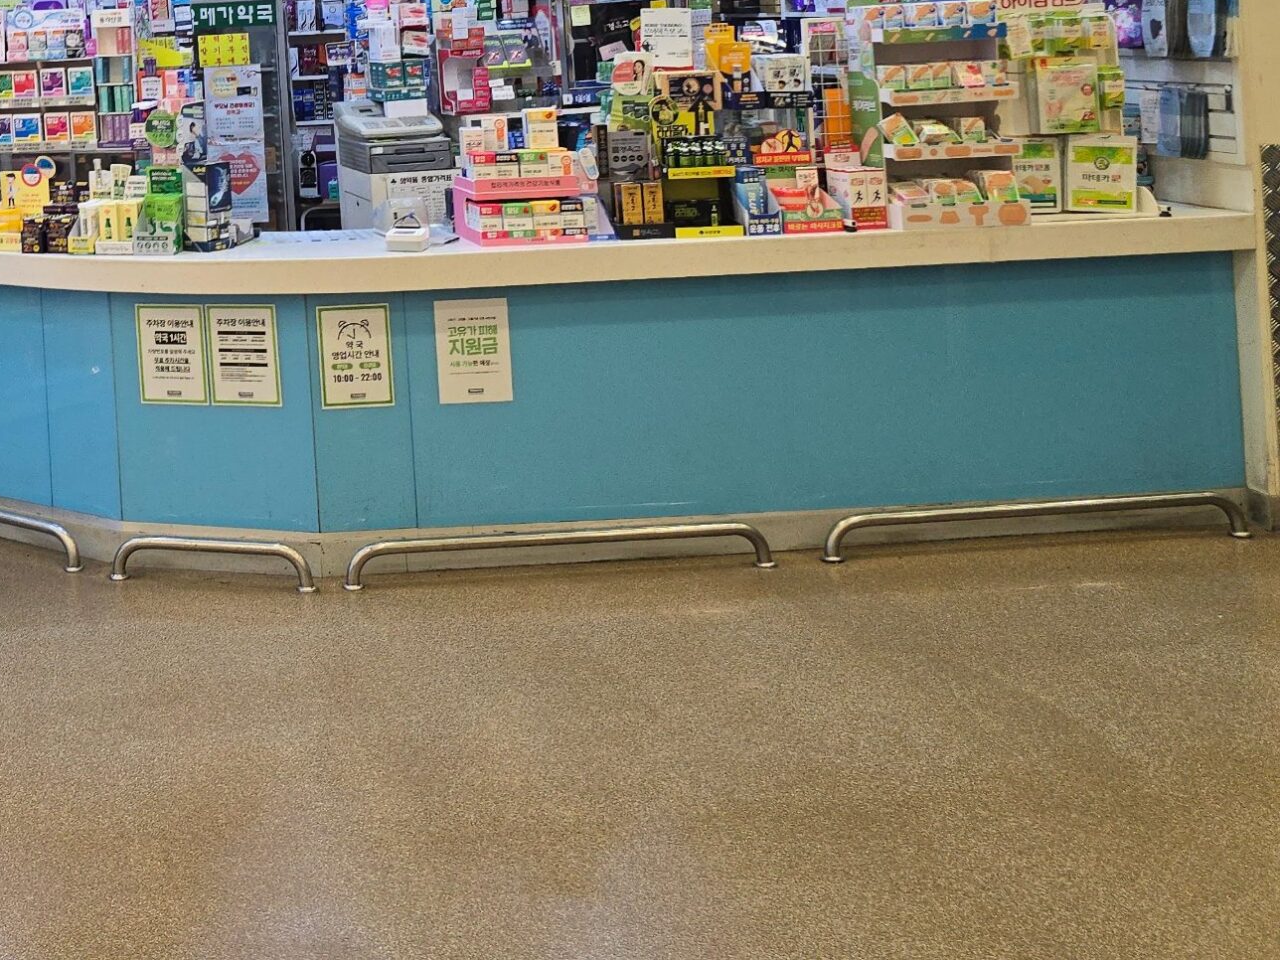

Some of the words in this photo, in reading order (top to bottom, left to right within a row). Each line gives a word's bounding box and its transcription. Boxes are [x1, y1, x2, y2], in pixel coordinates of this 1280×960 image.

[448, 337, 499, 357] 지원금
[331, 350, 363, 360] 영업시간
[363, 349, 380, 359] 안내
[332, 373, 354, 384] 10:00
[360, 372, 383, 382] 22:00
